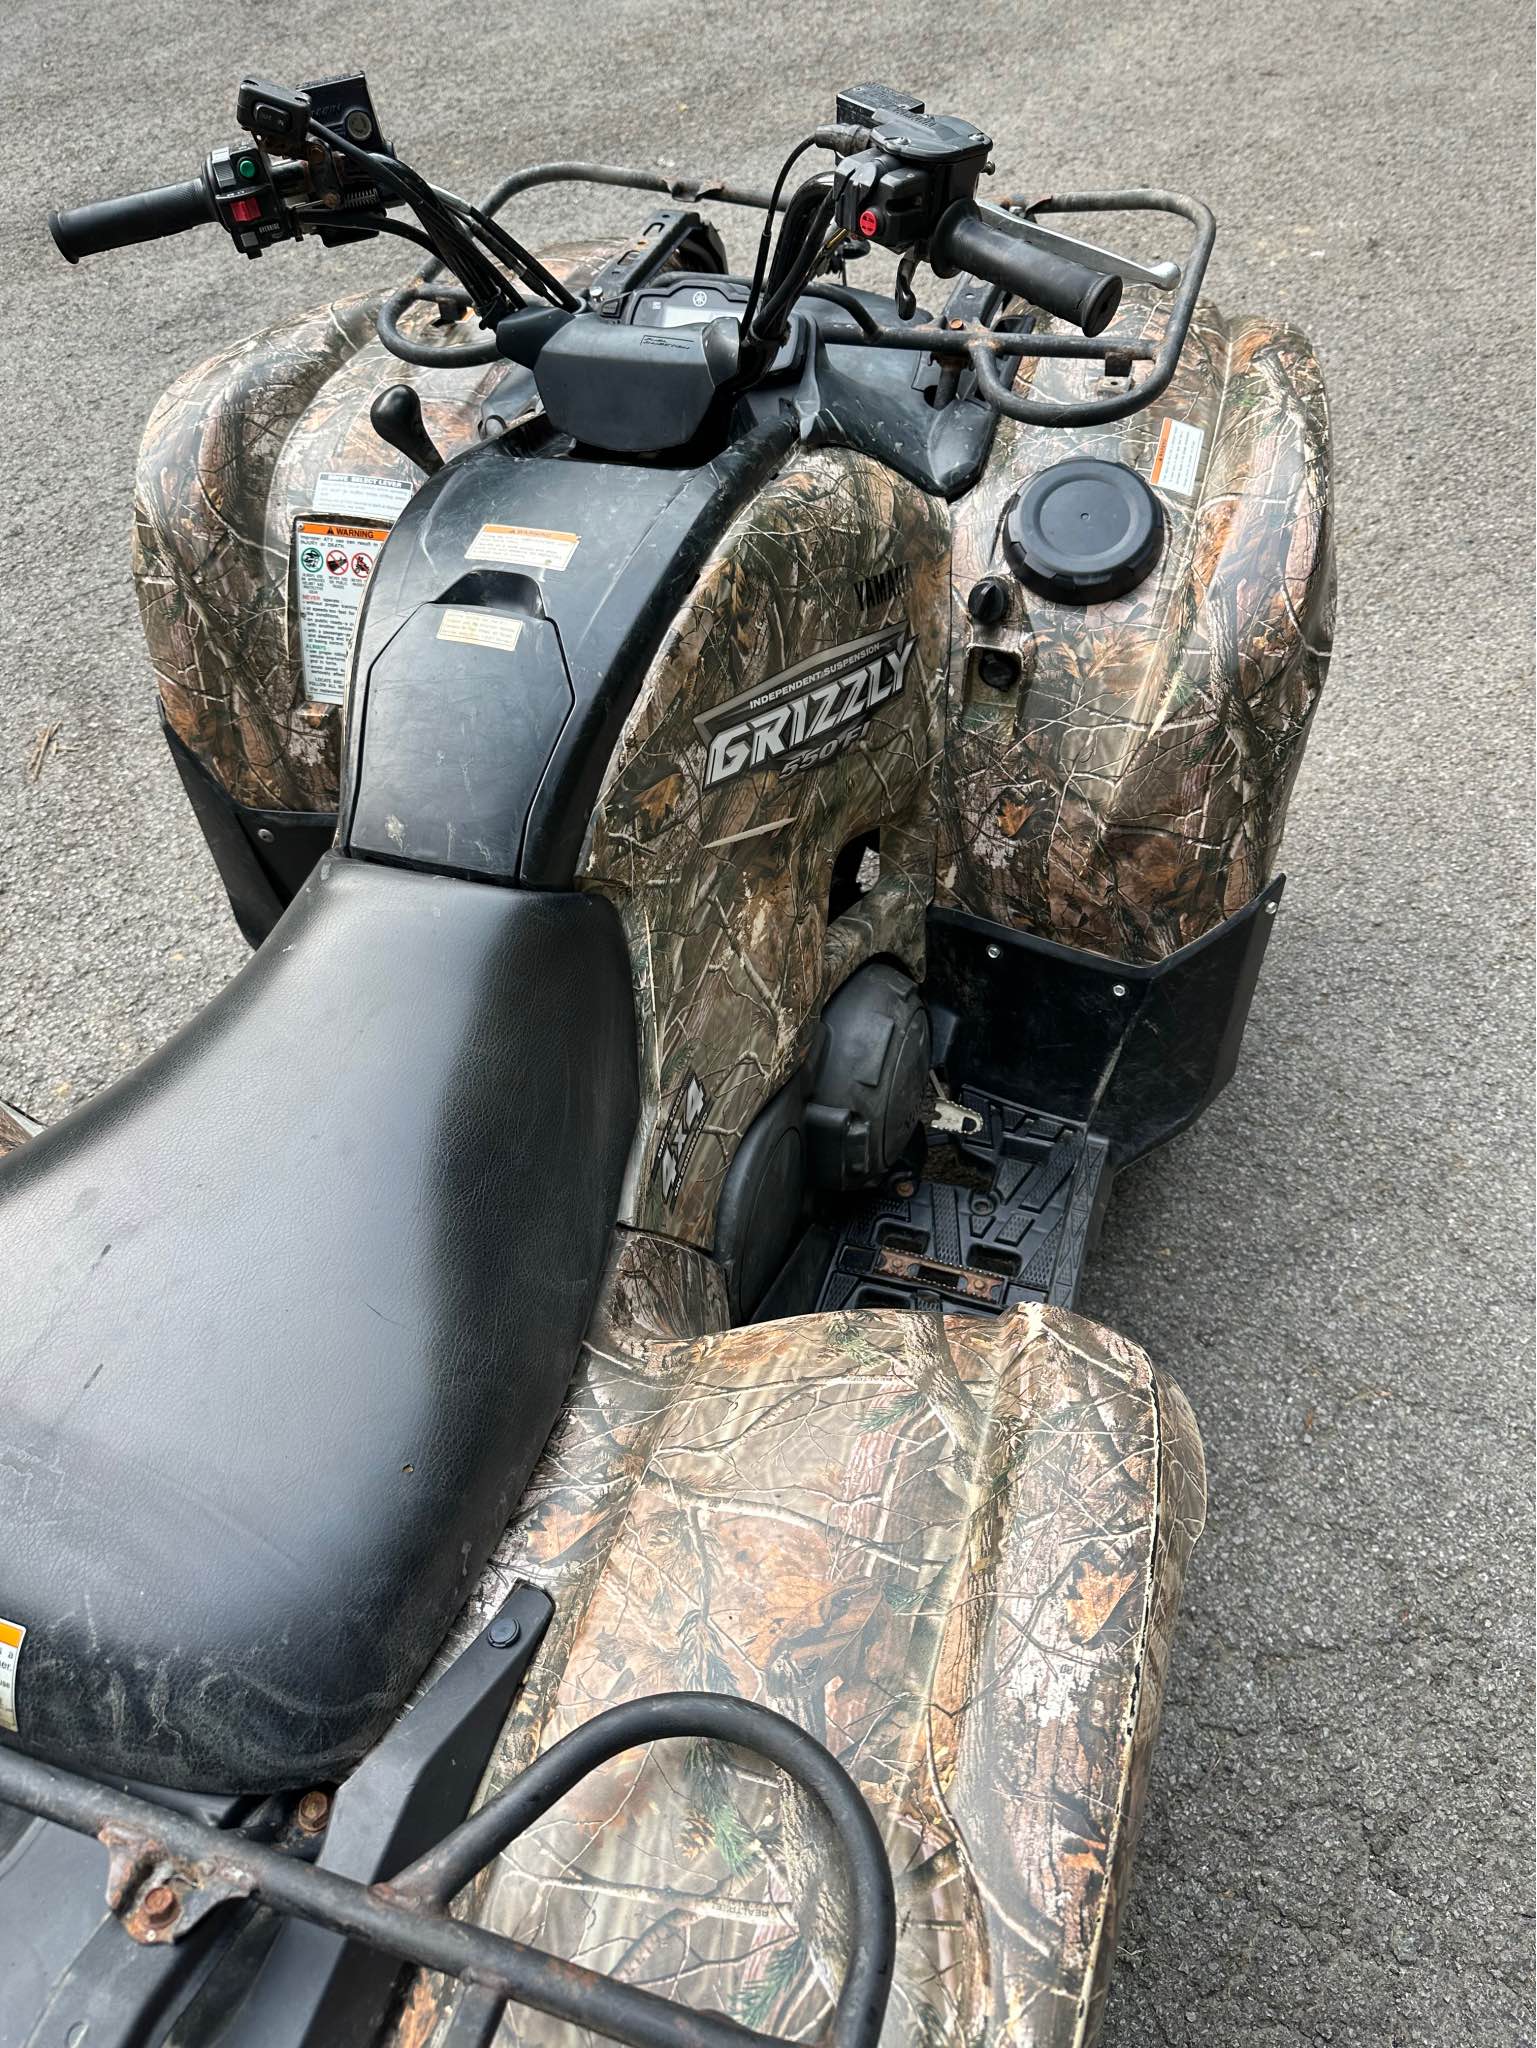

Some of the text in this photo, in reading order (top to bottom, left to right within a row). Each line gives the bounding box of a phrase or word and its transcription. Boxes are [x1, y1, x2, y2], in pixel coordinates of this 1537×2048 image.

[336, 527, 374, 539] WARNING
[749, 642, 881, 710] INDEPENDENT SUSPENSION
[706, 635, 918, 787] GRIZZLY
[779, 720, 871, 779] 550 FI
[681, 1112, 708, 1177] COMMAND
